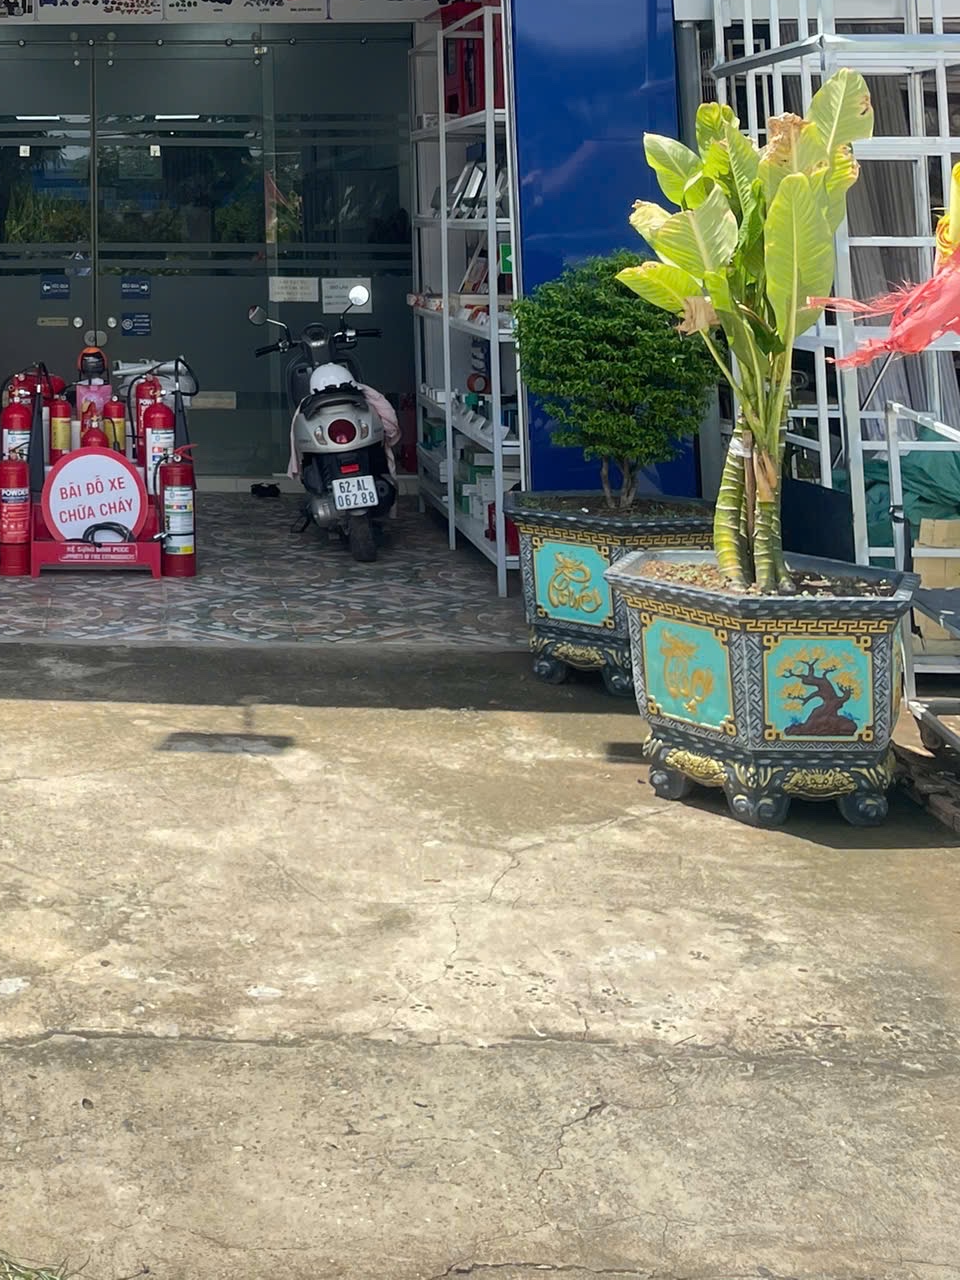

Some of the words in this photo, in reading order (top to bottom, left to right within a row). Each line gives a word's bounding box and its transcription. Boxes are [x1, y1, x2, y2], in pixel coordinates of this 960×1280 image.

[59, 482, 81, 500] BÃI
[86, 475, 104, 495] ĐỖ
[108, 476, 126, 491] XE
[59, 504, 96, 523] CHỮA
[100, 497, 133, 517] CHÁY
